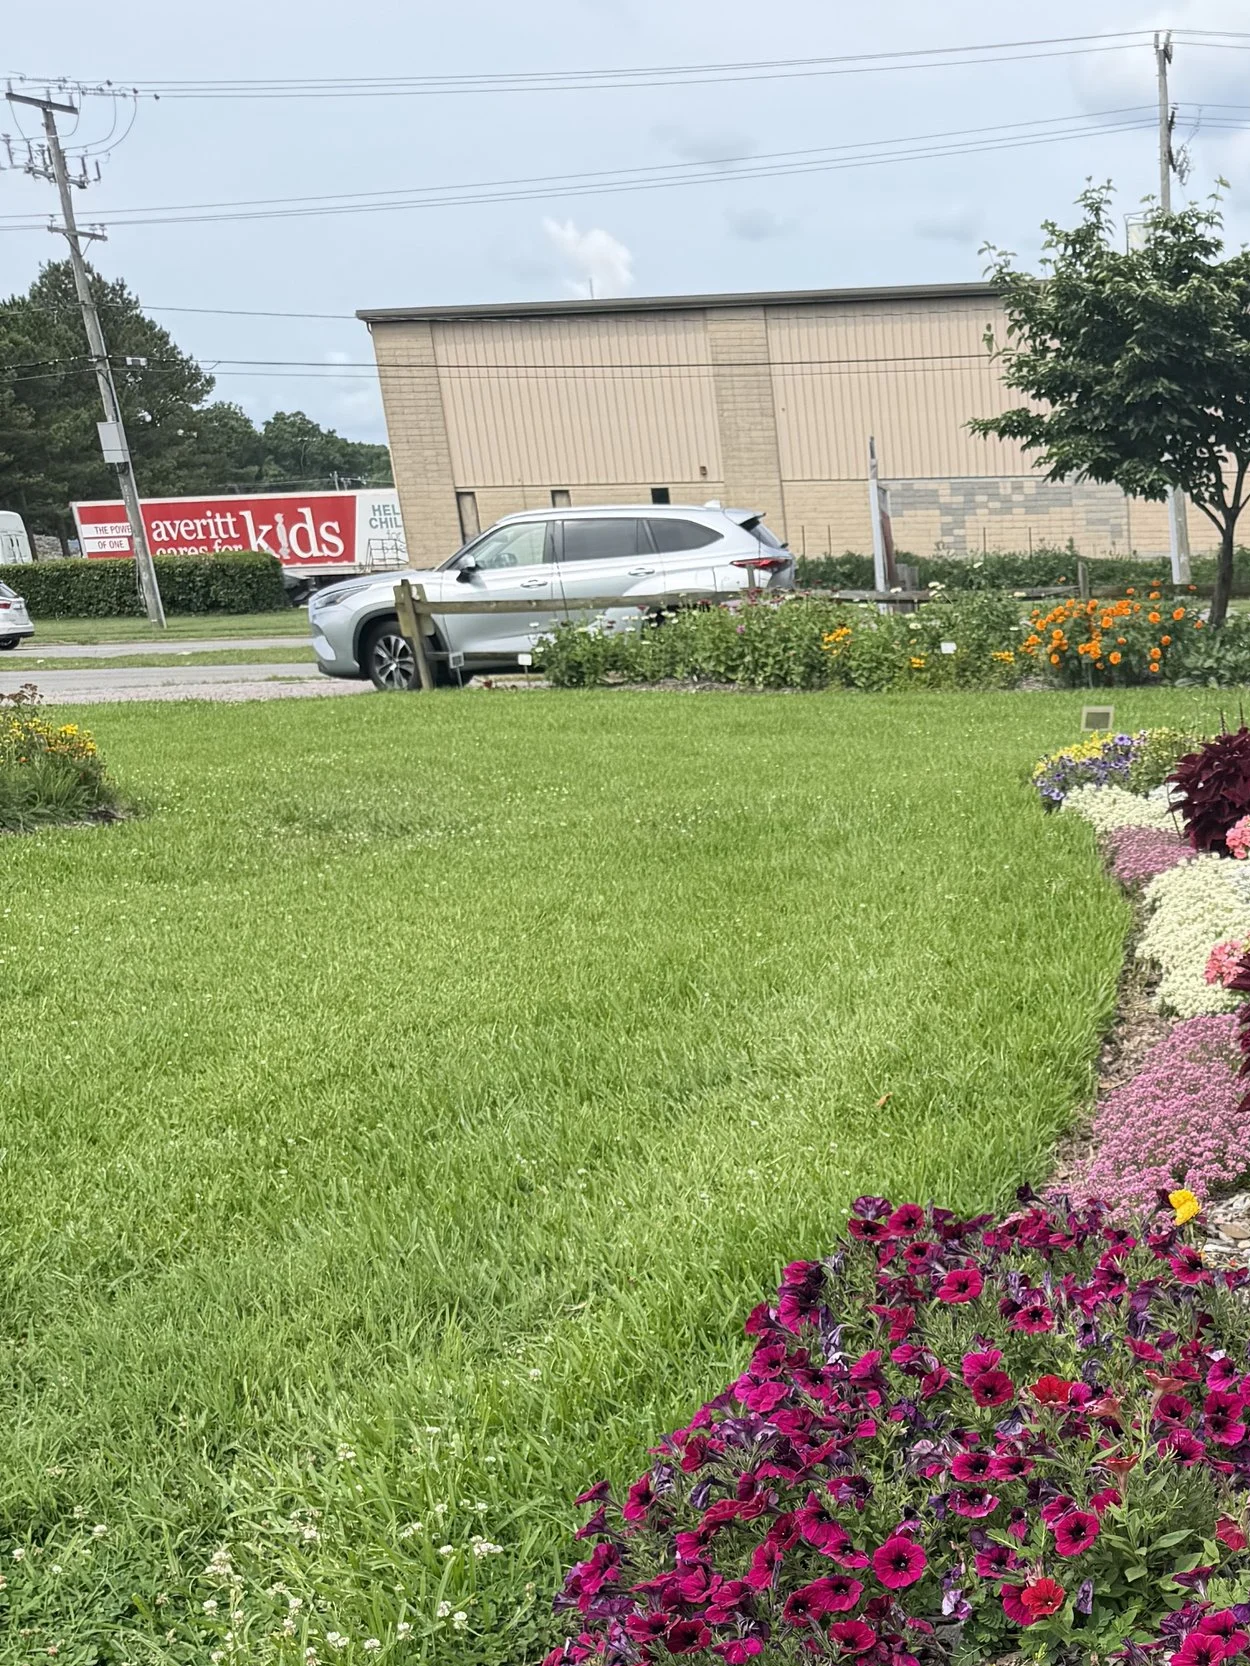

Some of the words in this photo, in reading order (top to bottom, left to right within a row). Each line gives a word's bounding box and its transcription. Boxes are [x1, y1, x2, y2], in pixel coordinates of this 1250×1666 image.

[371, 504, 401, 516] HEL
[94, 525, 109, 535] THE
[110, 523, 132, 534] POWE
[368, 517, 403, 529] CHIL
[151, 510, 240, 542] averitt
[239, 507, 344, 560] kids
[97, 540, 108, 549] OF
[108, 539, 124, 549] ONE
